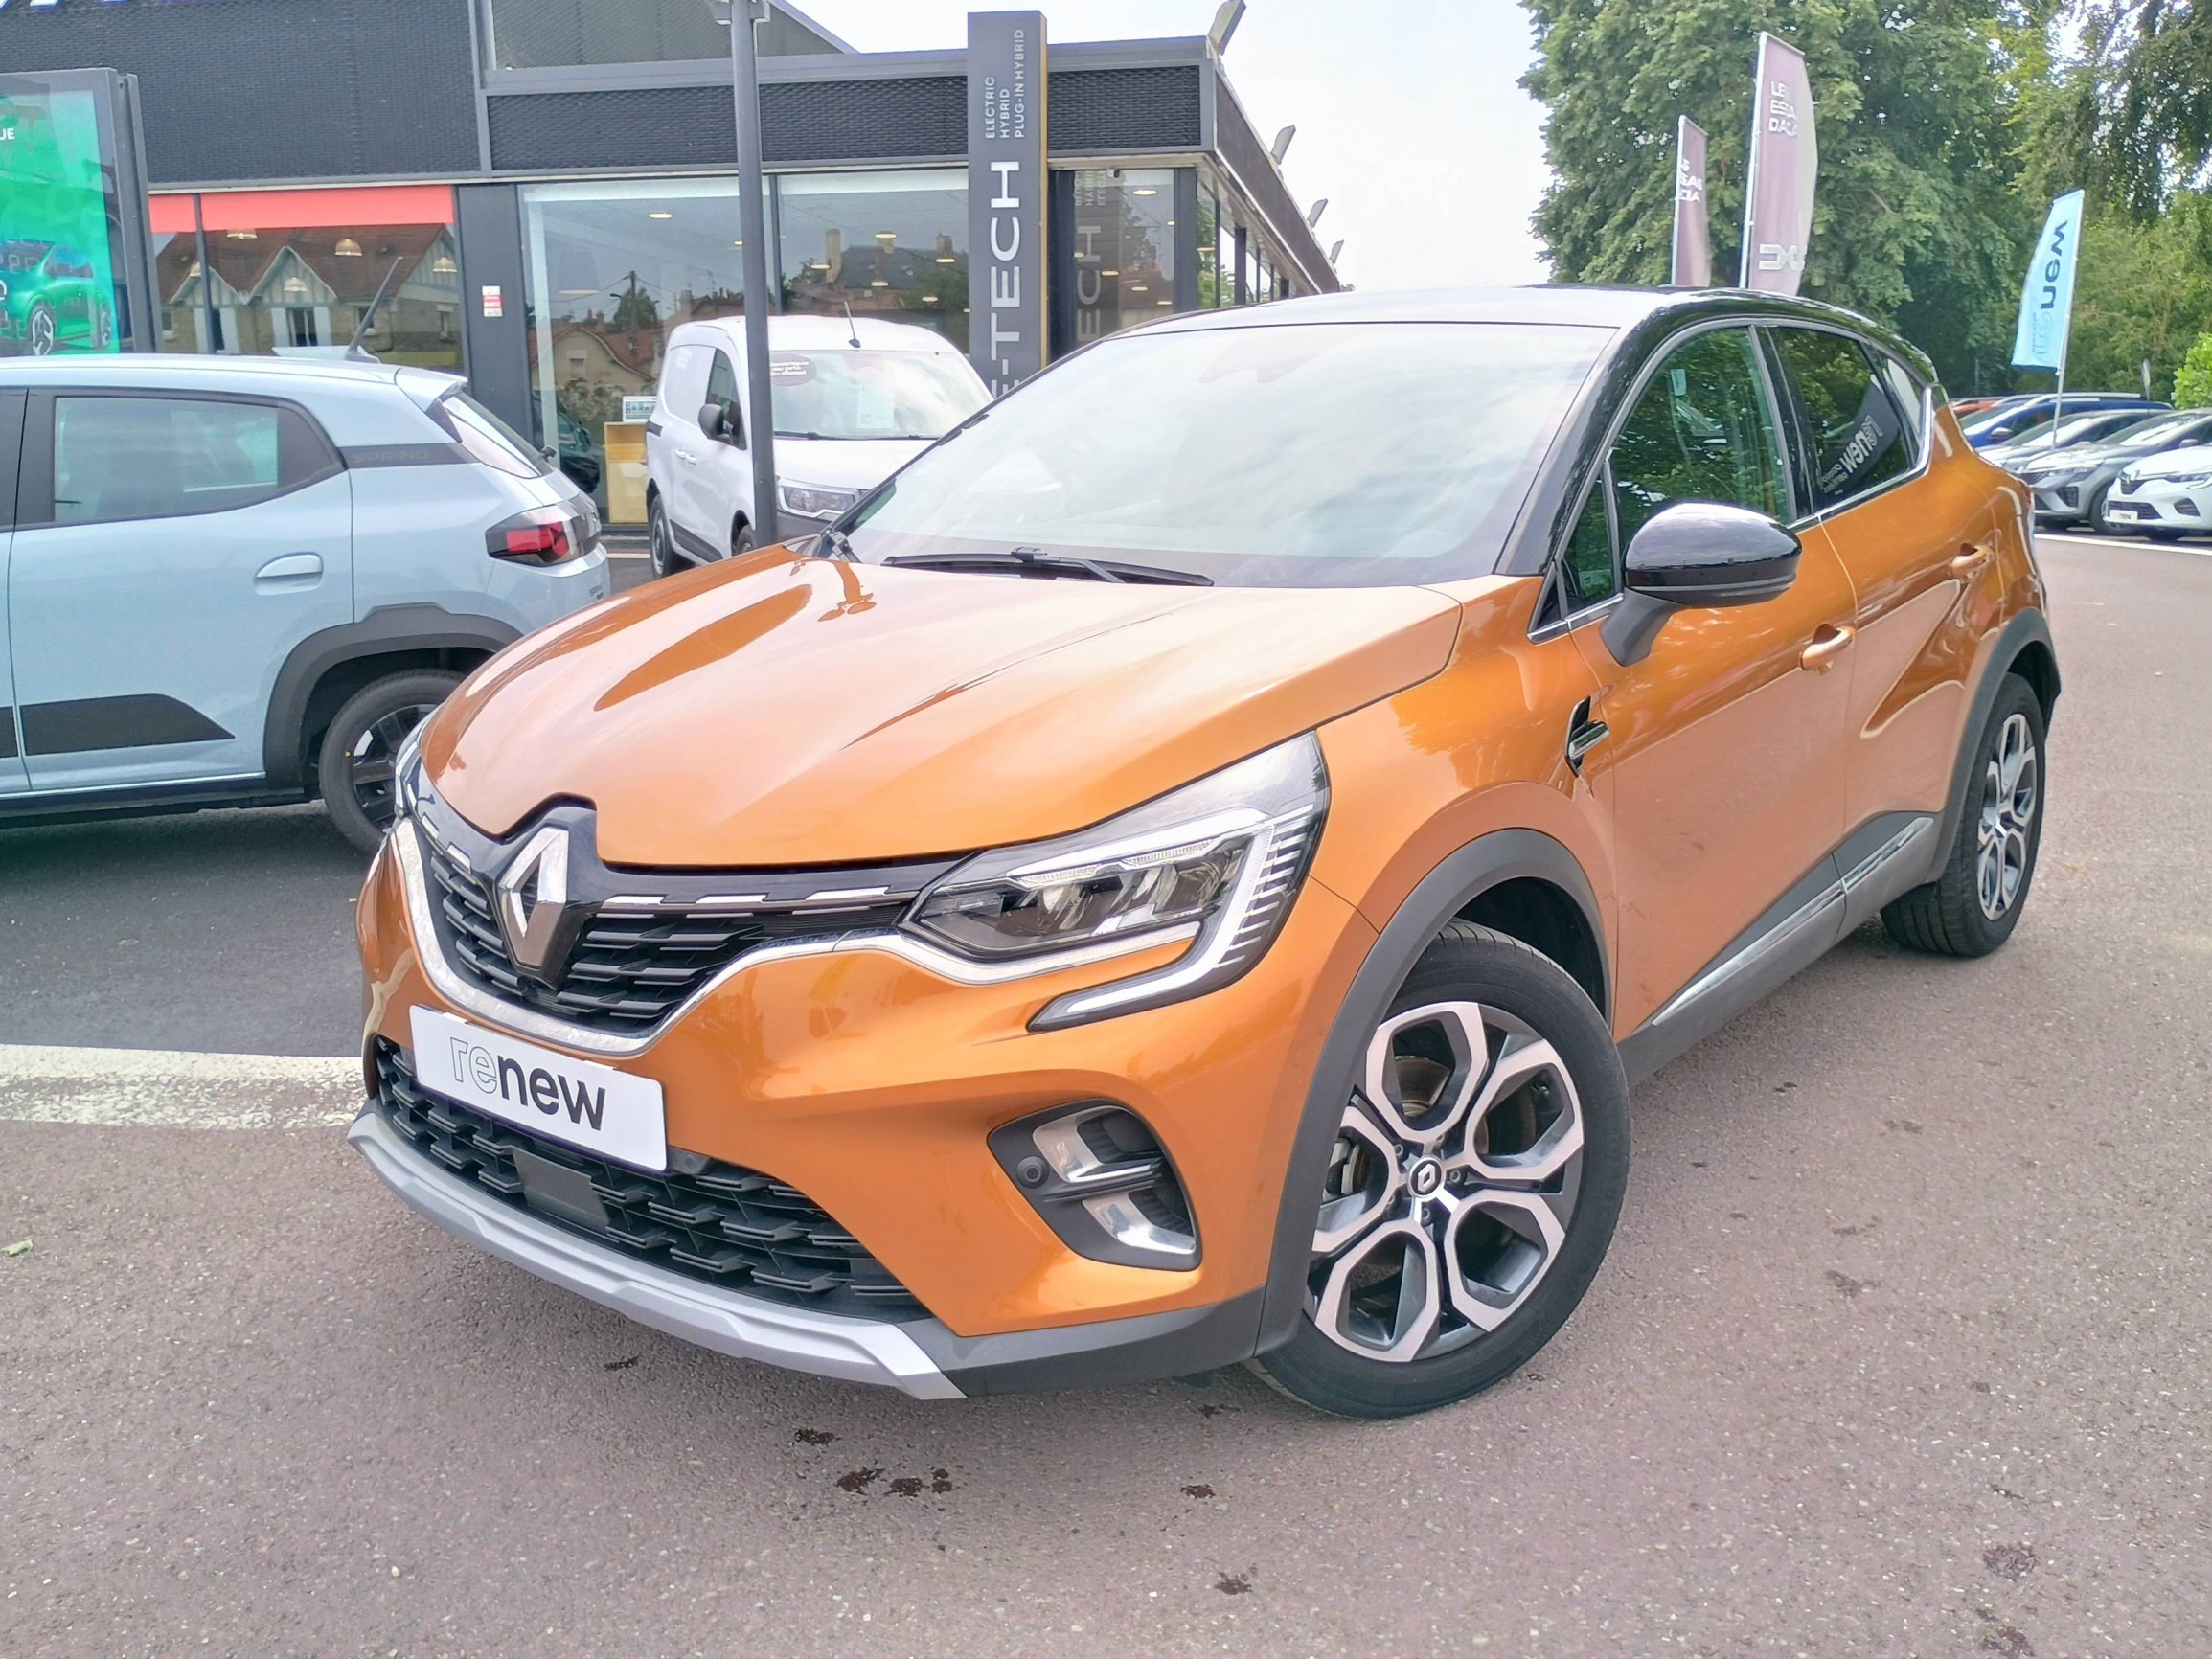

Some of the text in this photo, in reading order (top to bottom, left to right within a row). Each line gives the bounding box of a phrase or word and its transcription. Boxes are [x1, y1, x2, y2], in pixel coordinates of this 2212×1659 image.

[985, 76, 995, 139] ELECTRIC
[999, 88, 1010, 138] HYBRID
[1014, 29, 1025, 138] PLUG-IN HYBRID
[353, 449, 429, 462] SPRING
[450, 1037, 606, 1131] renew
